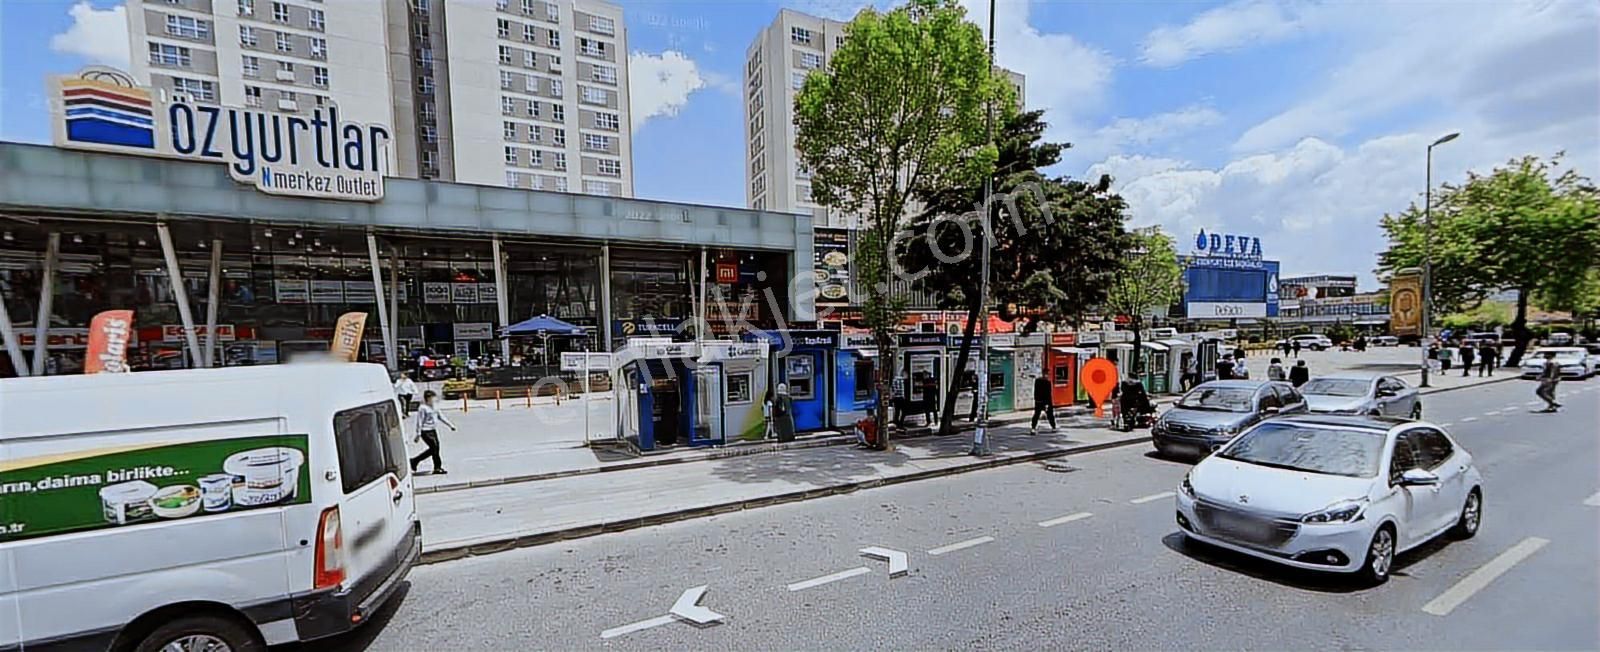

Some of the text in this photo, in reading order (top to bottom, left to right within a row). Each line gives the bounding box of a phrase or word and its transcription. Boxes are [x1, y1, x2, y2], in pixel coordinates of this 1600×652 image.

[273, 170, 332, 193] merkez
[336, 174, 377, 197] Outlet
[1210, 233, 1262, 256] DEVA
